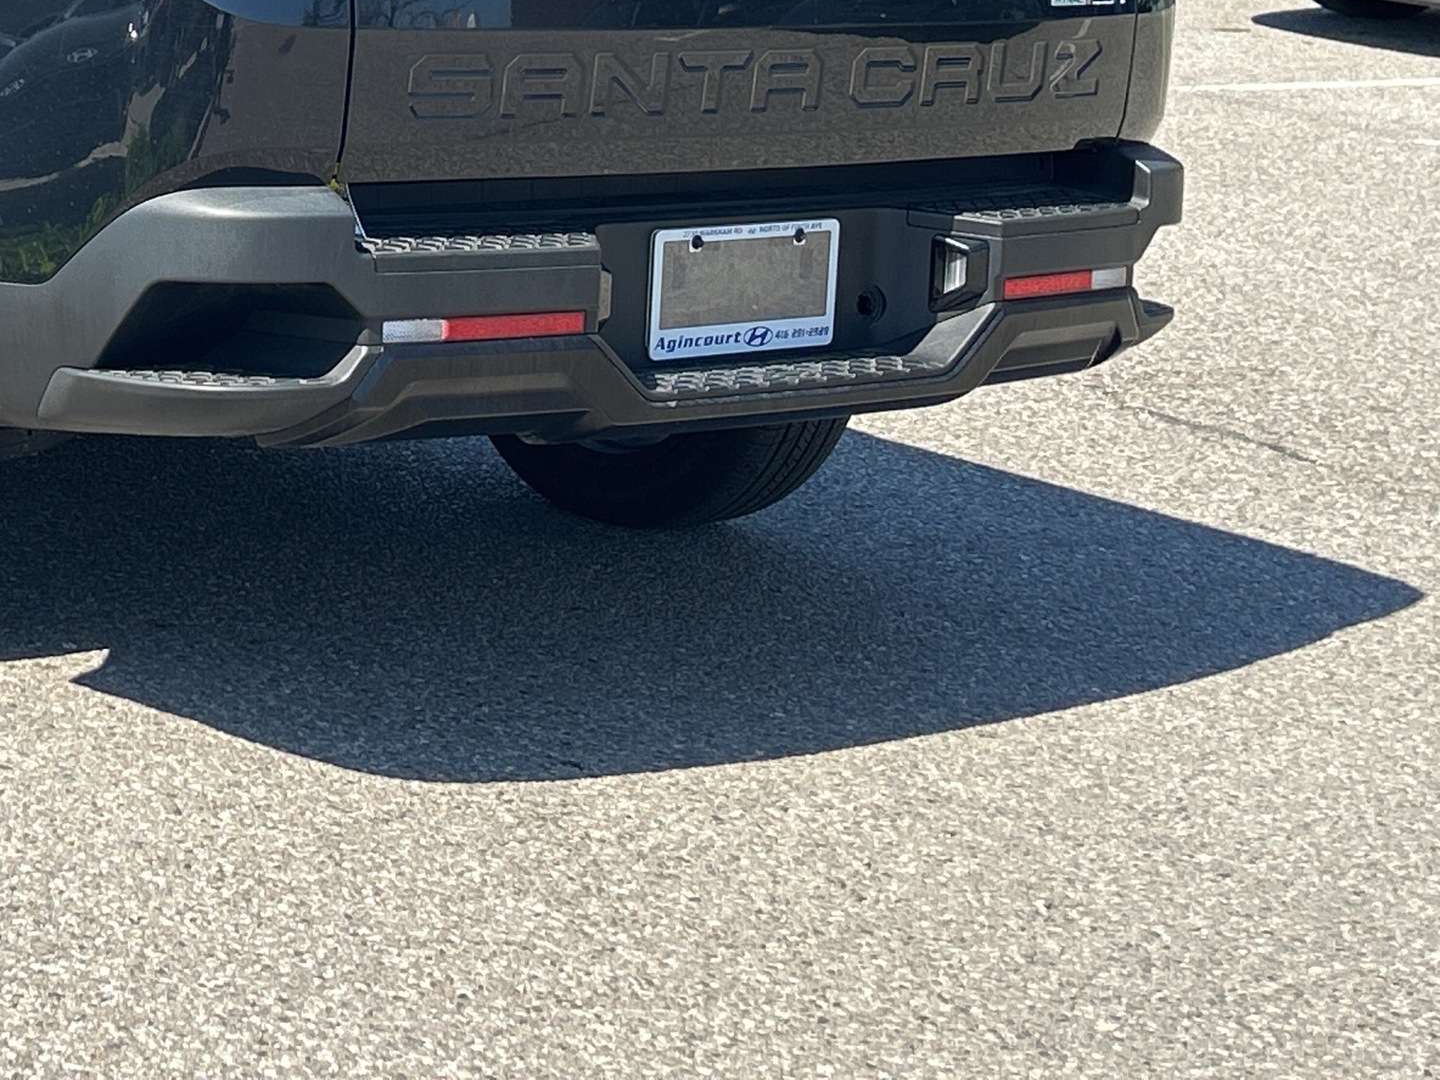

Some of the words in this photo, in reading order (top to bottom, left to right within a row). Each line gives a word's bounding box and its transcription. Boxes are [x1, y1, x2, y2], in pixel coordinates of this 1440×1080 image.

[407, 48, 823, 119] SANTA
[849, 38, 1103, 109] CRUZ
[654, 331, 741, 353] Agincourt
